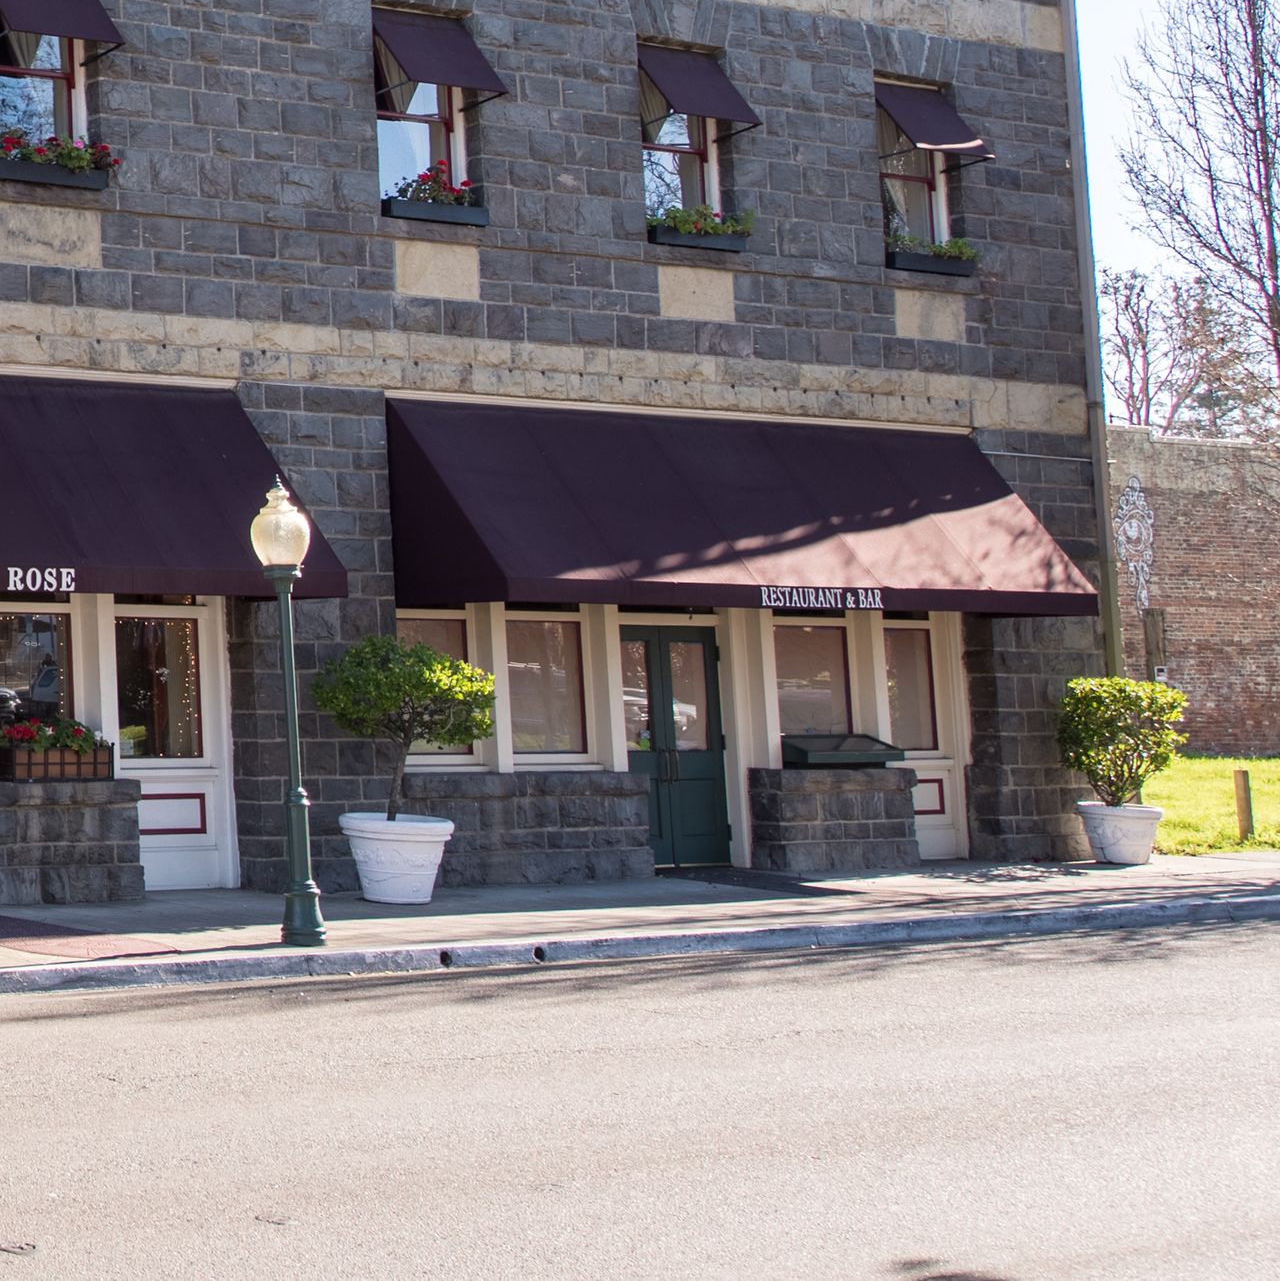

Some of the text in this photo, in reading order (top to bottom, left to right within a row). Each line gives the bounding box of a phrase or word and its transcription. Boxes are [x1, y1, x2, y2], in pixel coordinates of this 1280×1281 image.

[7, 567, 76, 592] ROSE
[760, 586, 884, 609] RESTAURANT & BAR
